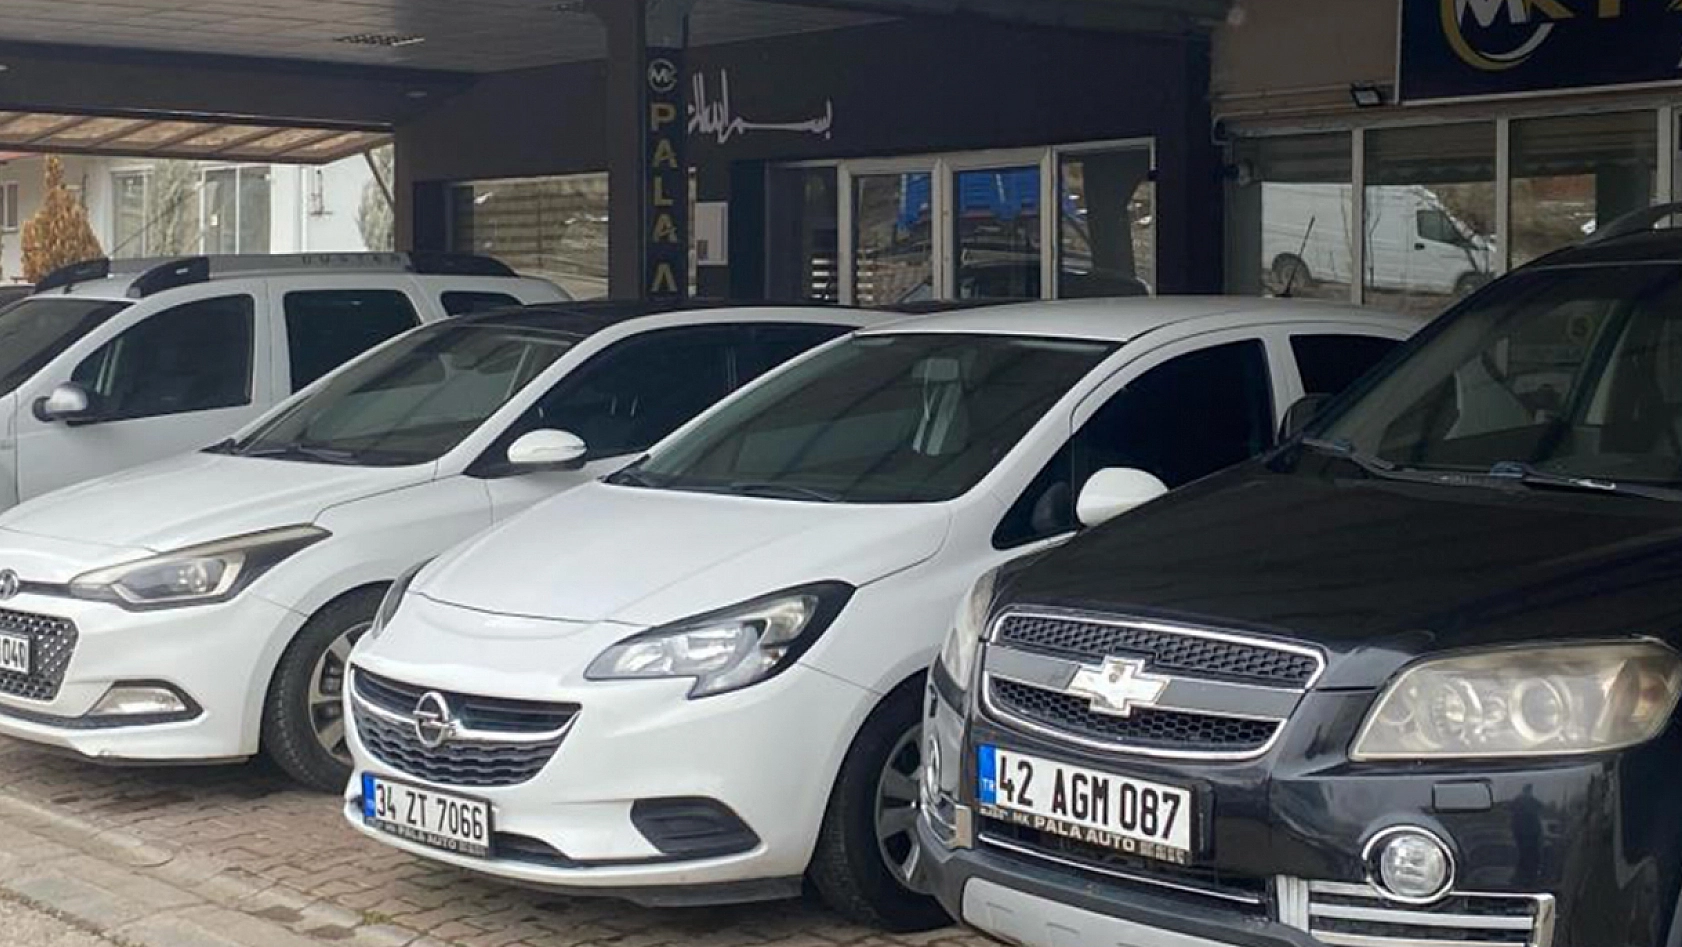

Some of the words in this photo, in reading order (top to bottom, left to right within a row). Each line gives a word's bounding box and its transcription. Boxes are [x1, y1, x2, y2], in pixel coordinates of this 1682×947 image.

[651, 102, 678, 243] PALA
[376, 783, 396, 821] 34
[405, 790, 428, 828] ZT
[436, 797, 483, 839] 7066
[999, 755, 1033, 807] 42
[1051, 768, 1109, 826] AGM
[1119, 782, 1182, 841] 087
[429, 831, 457, 850] AUTO
[1035, 814, 1081, 840] PALA
[1084, 828, 1135, 853] AUTO
